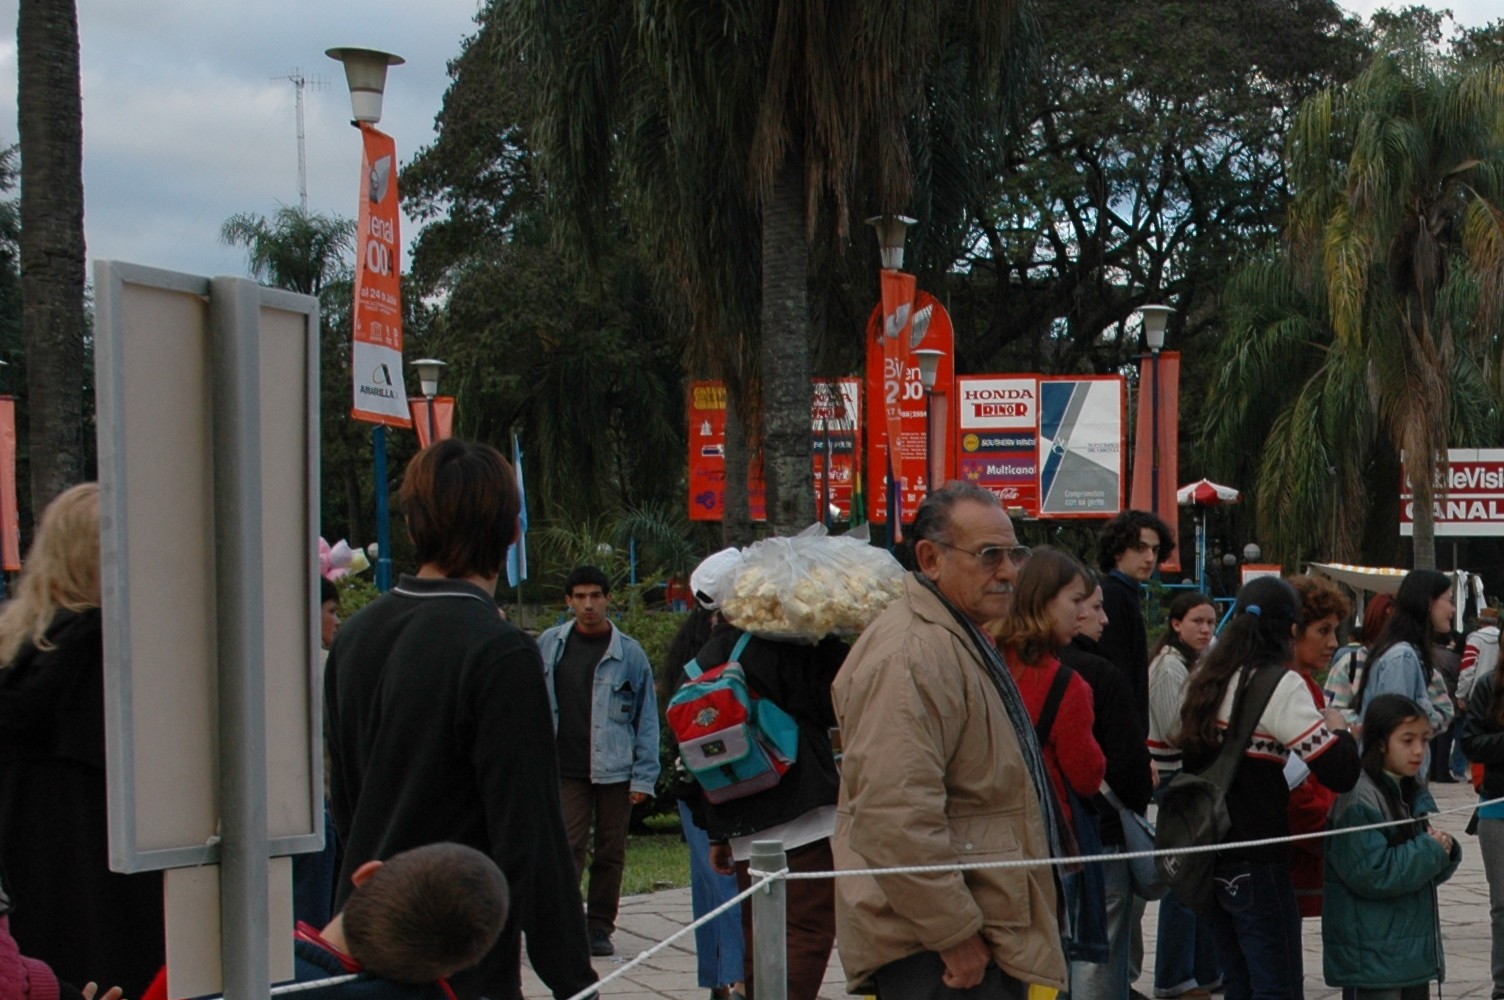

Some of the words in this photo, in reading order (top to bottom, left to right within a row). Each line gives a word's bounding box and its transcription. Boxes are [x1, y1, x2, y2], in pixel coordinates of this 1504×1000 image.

[367, 215, 394, 245] ienal
[365, 240, 394, 279] 004
[965, 389, 1034, 400] HONDA
[987, 464, 1036, 475] Multicanal
